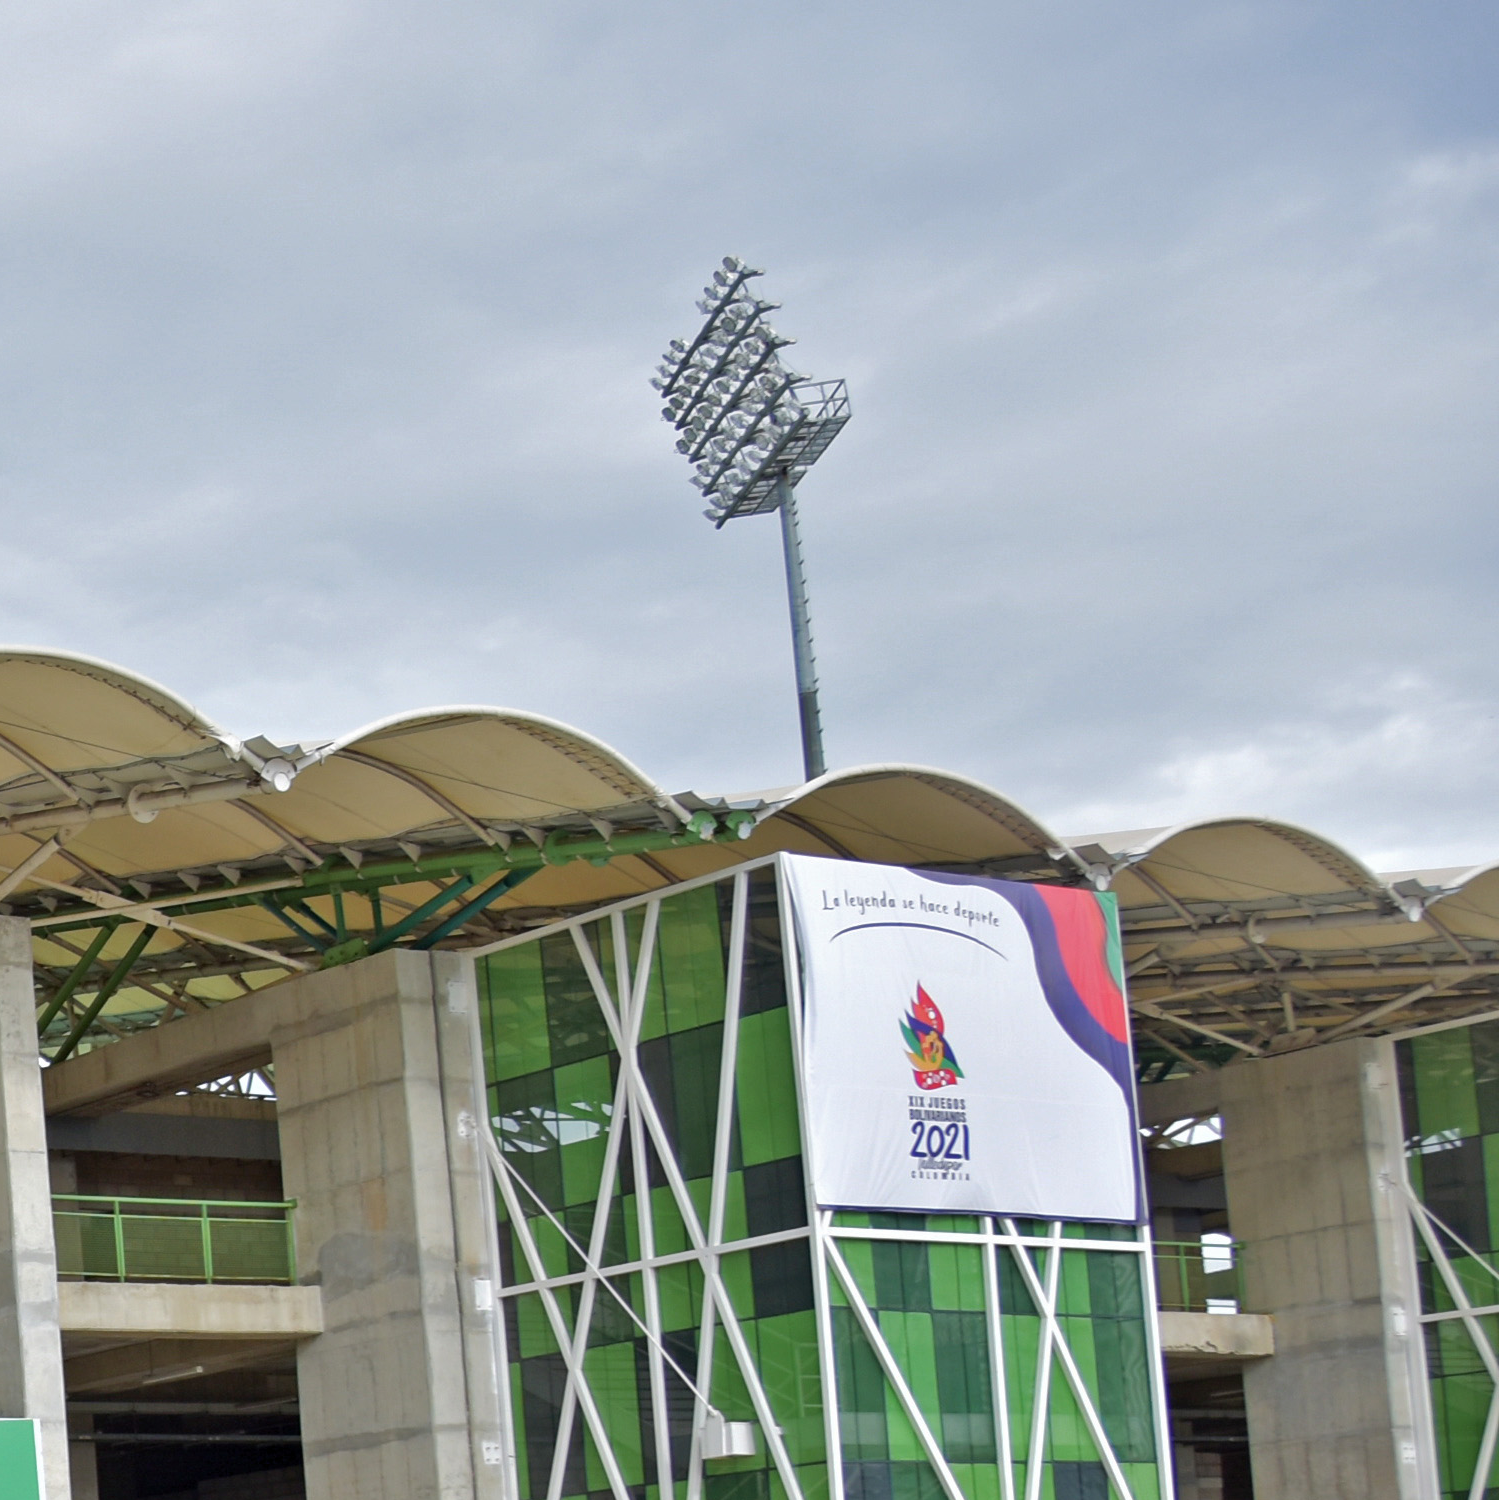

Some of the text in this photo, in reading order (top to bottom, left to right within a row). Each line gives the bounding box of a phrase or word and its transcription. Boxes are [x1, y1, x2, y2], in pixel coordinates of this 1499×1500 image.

[822, 889, 999, 927] La leyenda se hace deporte
[908, 1096, 966, 1110] XIX JUEGOS
[909, 1109, 966, 1123] BOLIVARIANOS
[910, 1121, 970, 1161] 2021
